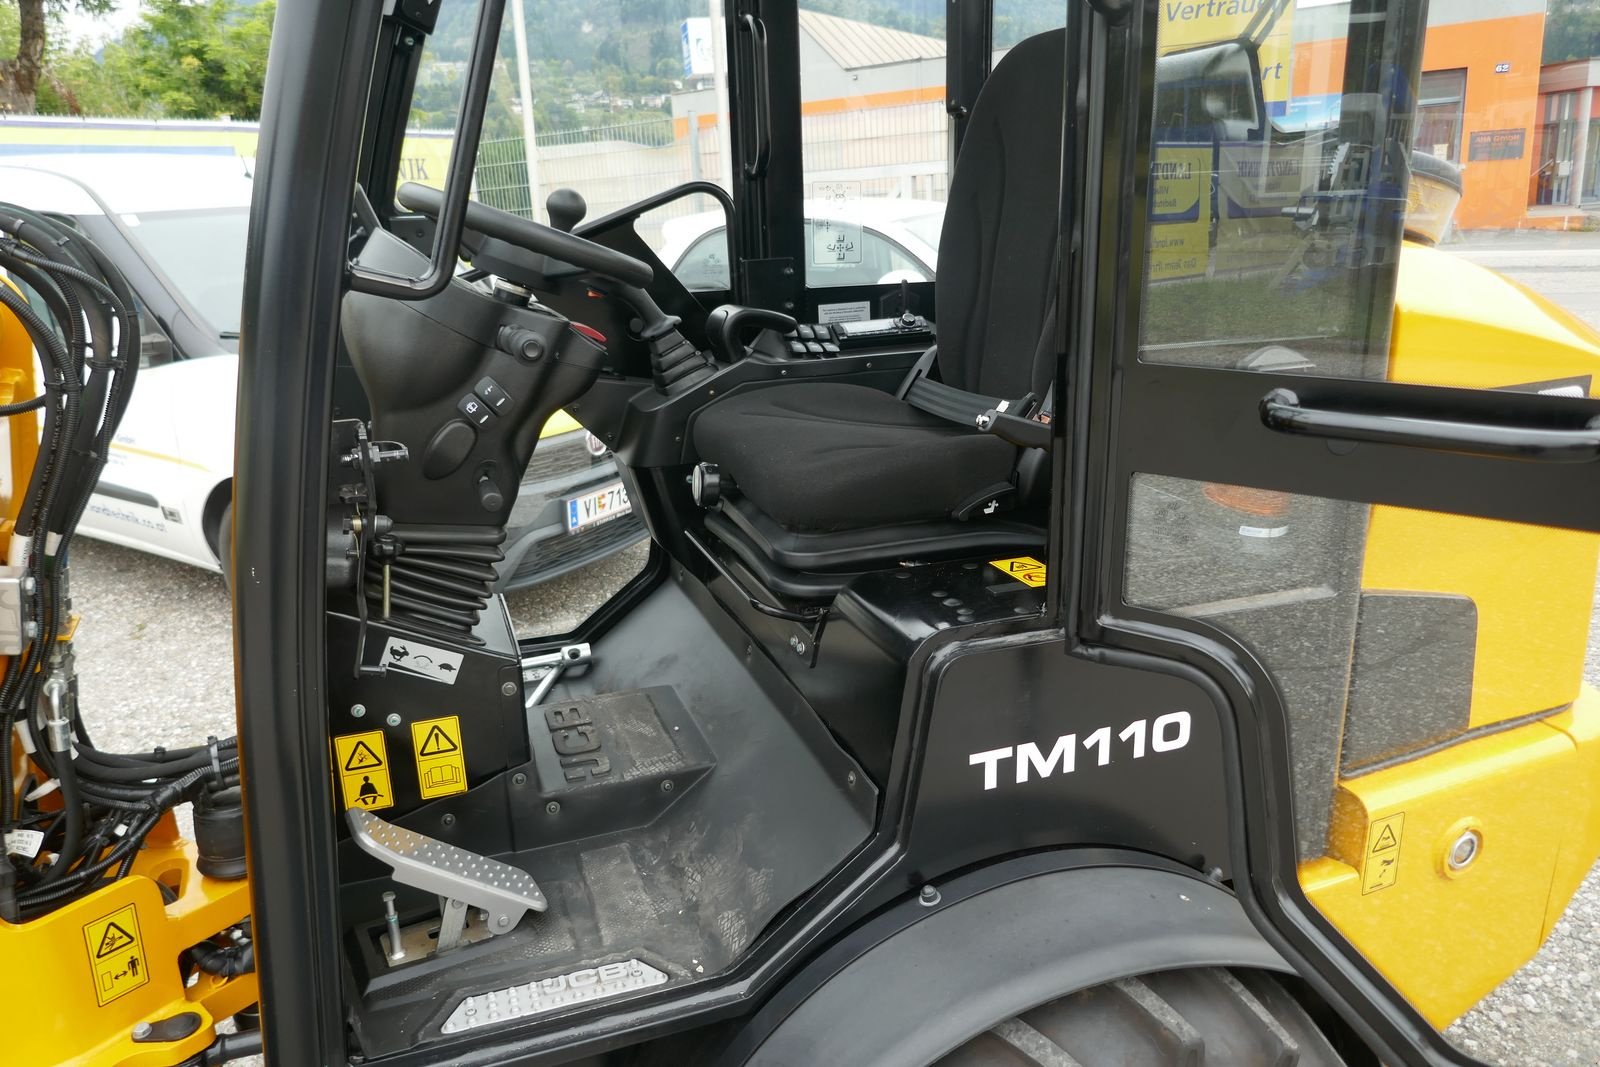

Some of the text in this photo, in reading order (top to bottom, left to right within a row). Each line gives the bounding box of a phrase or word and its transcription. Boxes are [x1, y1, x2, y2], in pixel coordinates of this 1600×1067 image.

[1496, 64, 1509, 72] 62
[544, 702, 611, 783] JCB
[969, 710, 1192, 791] TM110
[542, 962, 628, 994] JCB
